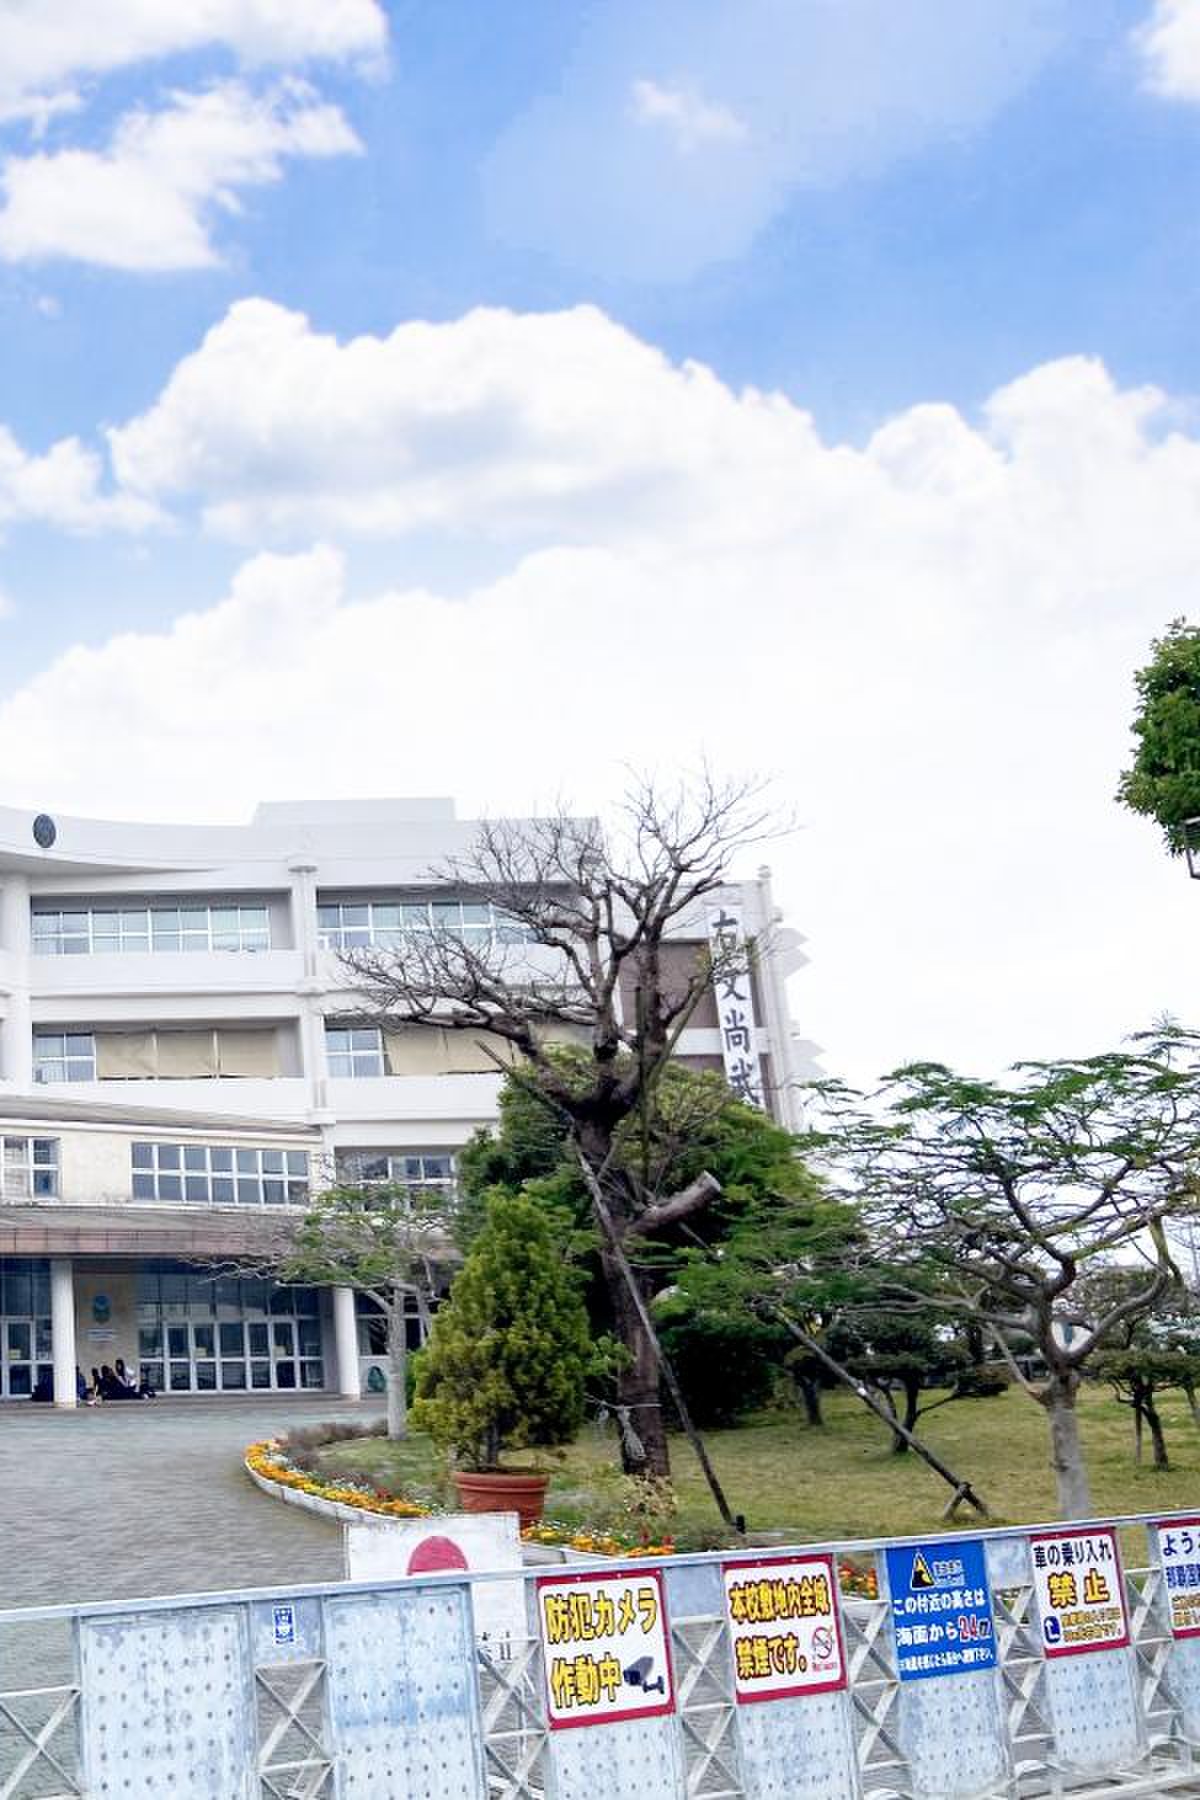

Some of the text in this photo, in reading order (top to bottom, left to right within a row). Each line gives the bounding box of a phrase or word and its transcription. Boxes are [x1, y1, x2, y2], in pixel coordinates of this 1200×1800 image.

[1033, 1539, 1112, 1569] 車の乗り入れ
[1163, 1531, 1200, 1557] よう
[729, 1574, 831, 1625] 本校敷地内全域
[893, 1588, 986, 1615] この付近の高さは
[1047, 1567, 1111, 1609] 禁止
[543, 1587, 658, 1645] 防犯カメラ
[550, 1652, 623, 1710] 作動中
